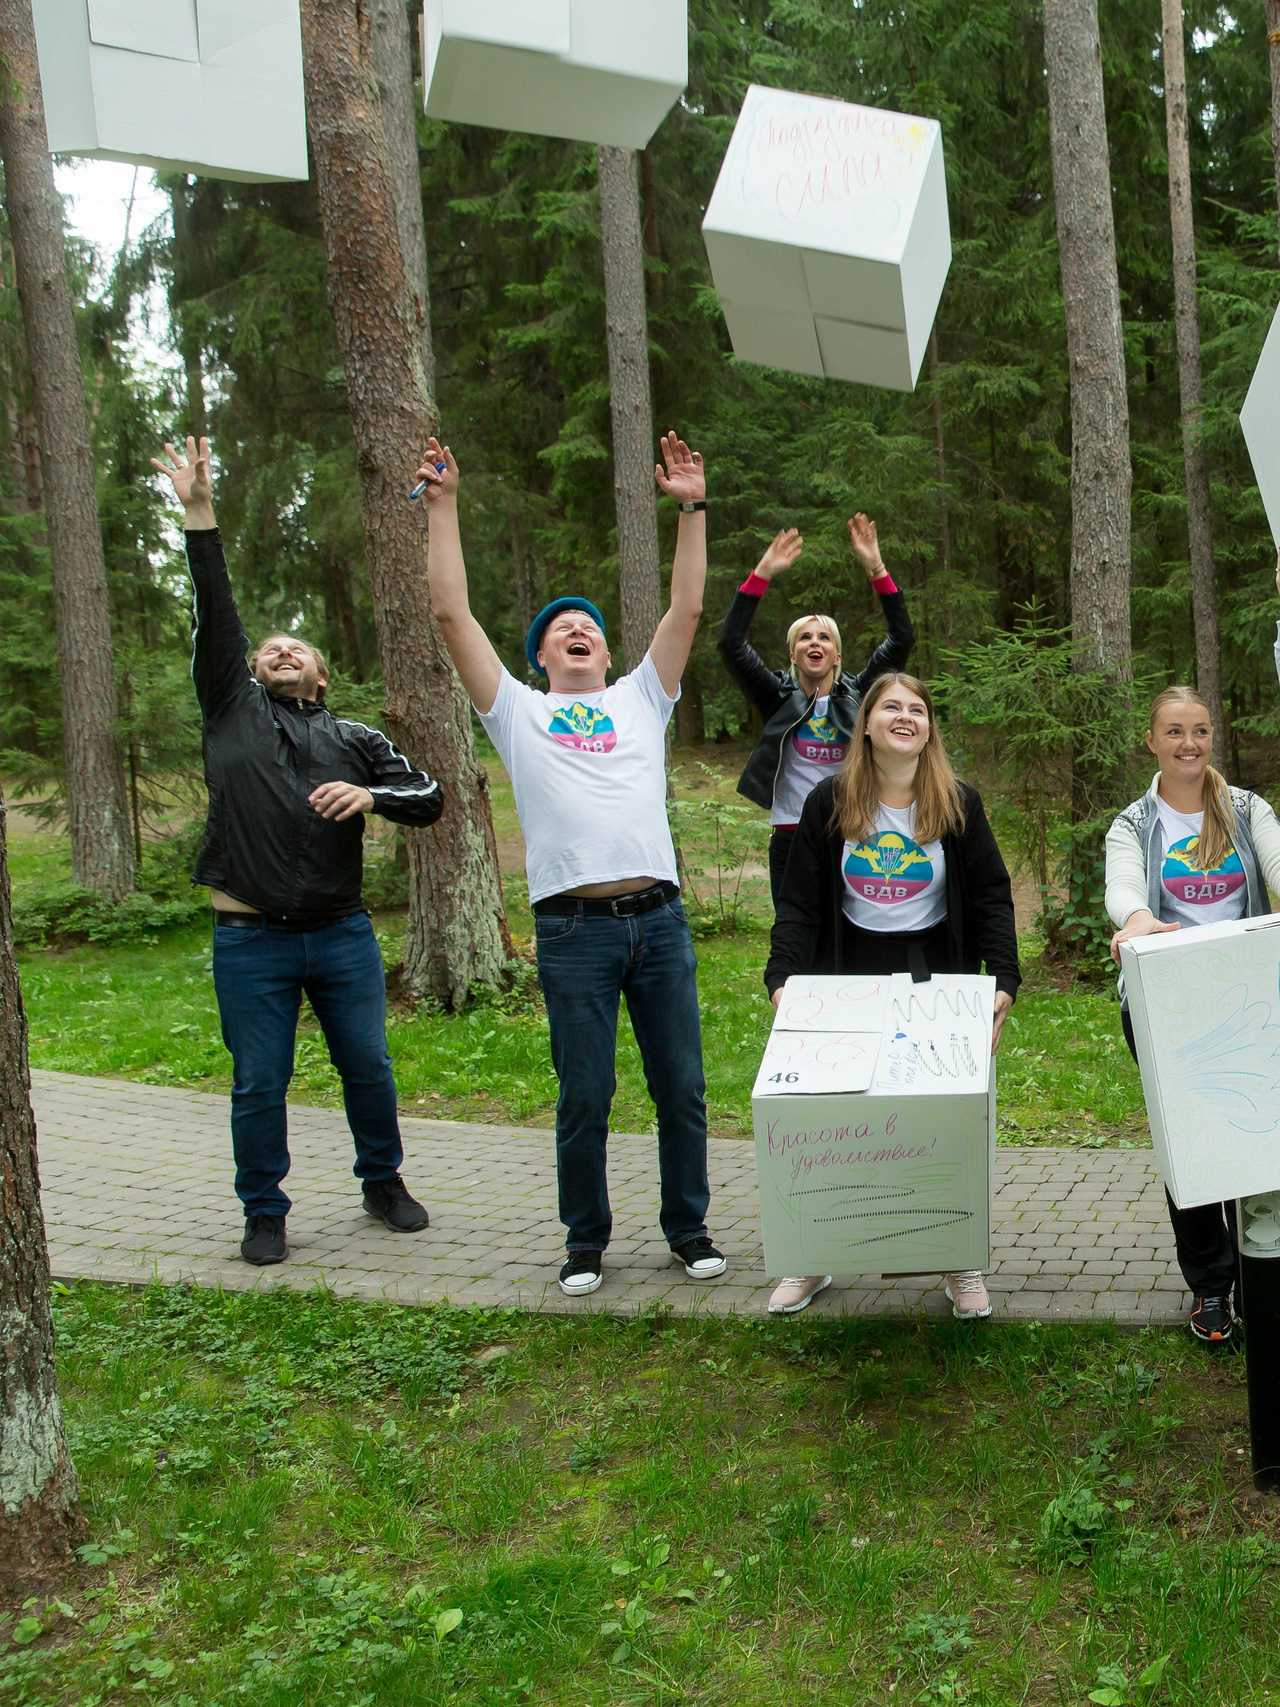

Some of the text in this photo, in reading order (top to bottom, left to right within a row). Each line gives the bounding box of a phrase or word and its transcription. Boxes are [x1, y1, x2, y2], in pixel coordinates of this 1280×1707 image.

[806, 745, 843, 760] ВДВ
[863, 884, 908, 900] ВДВ
[1183, 882, 1228, 900] ВДВ
[767, 1071, 800, 1085] 46
[766, 1112, 898, 1157] Красота в
